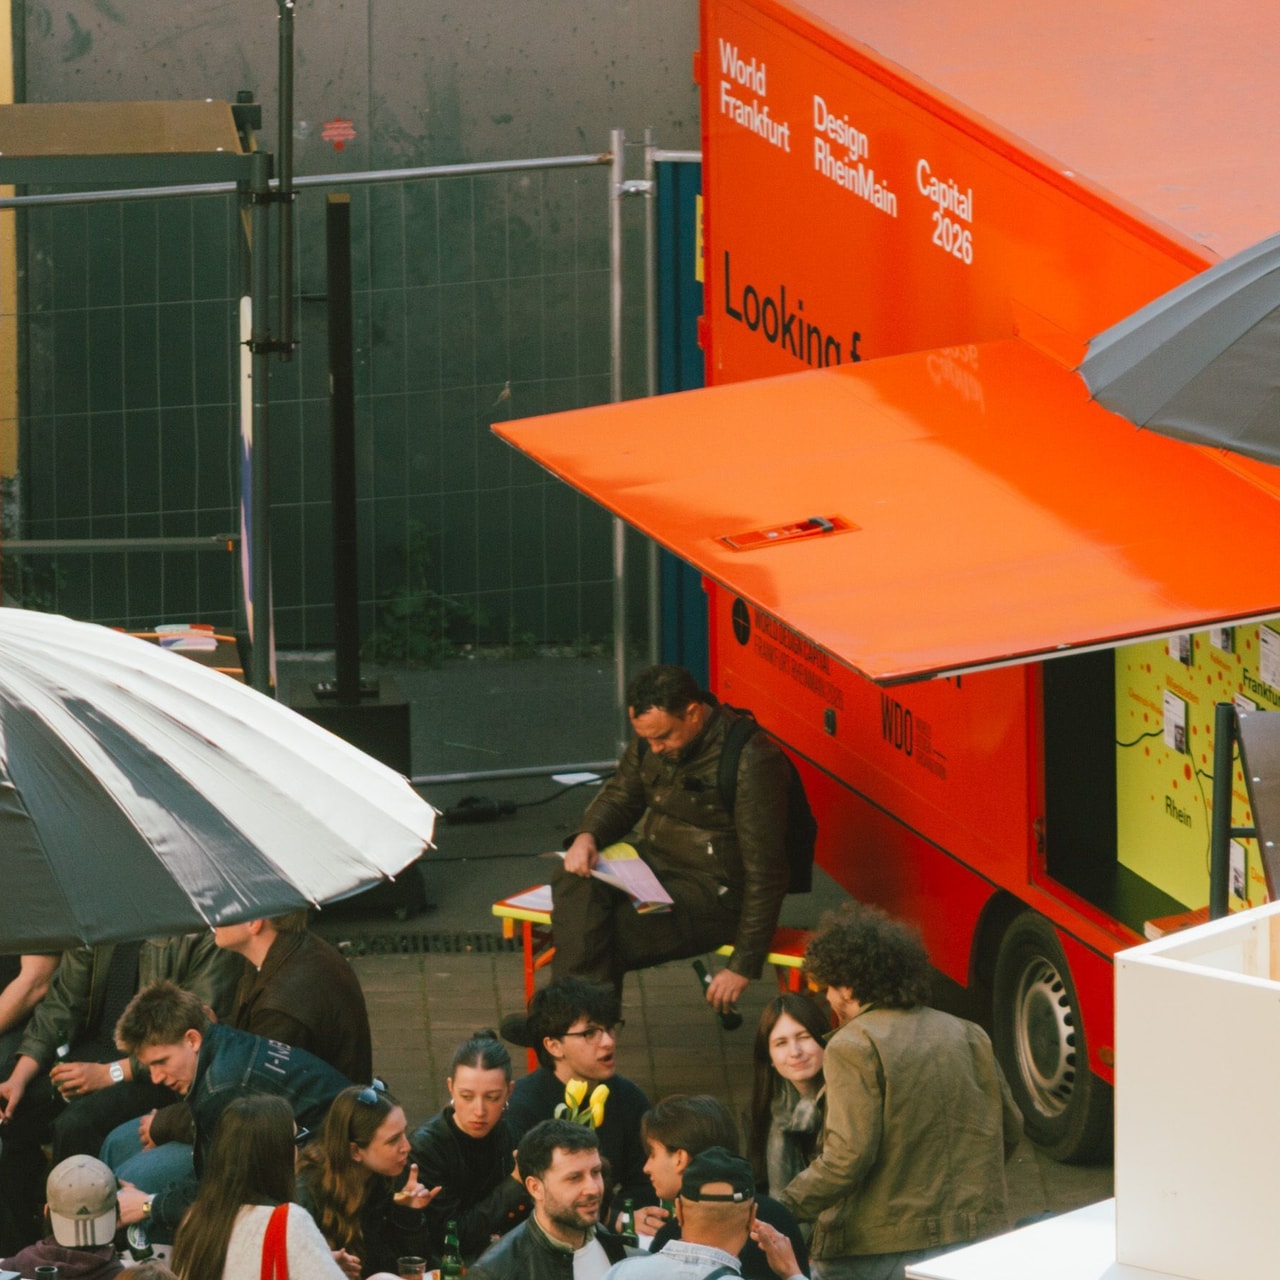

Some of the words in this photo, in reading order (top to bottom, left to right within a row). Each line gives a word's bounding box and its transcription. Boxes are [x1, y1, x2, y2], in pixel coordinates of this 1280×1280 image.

[719, 38, 766, 97] World
[720, 81, 790, 153] Frankfurt
[813, 95, 869, 160] Design
[814, 137, 897, 218] RheinMain
[916, 158, 973, 224] Capital
[932, 213, 973, 266] 2026
[881, 692, 913, 757] WDO
[1165, 795, 1193, 829] Rhein
